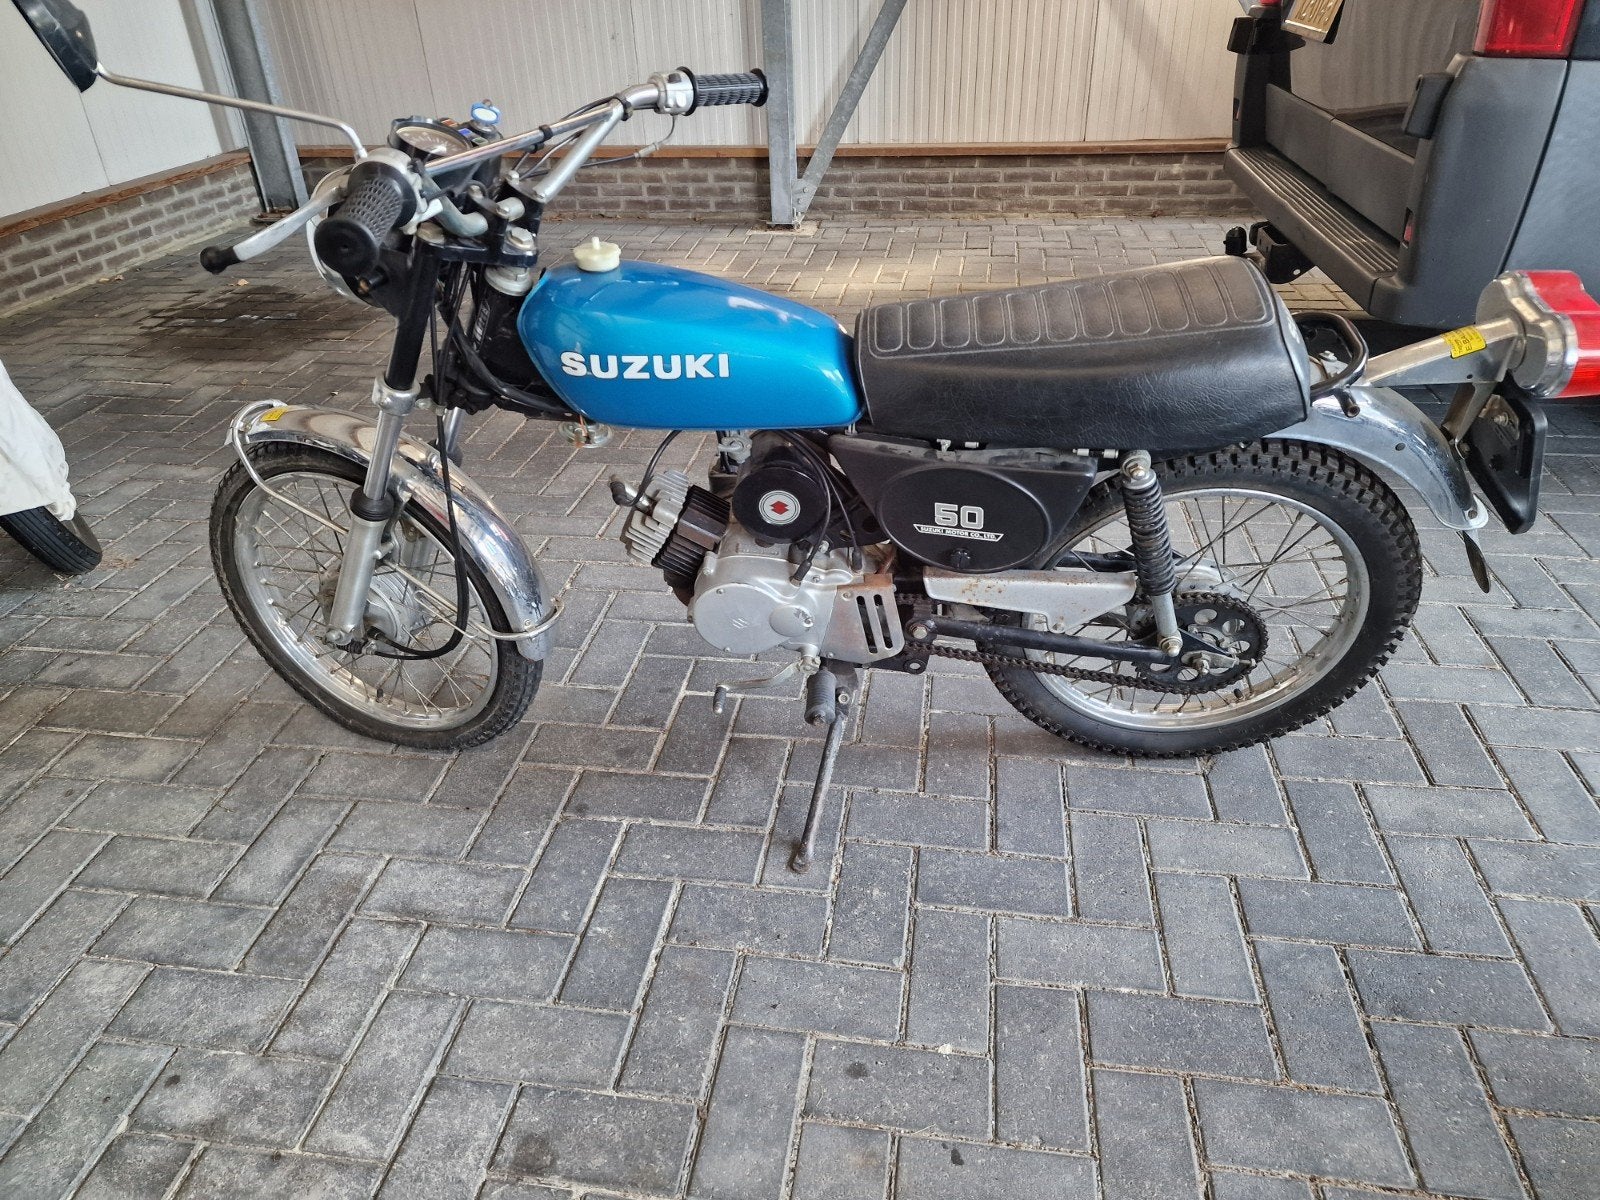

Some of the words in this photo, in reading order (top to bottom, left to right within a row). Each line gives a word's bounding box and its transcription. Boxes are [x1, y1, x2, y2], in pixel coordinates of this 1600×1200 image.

[560, 351, 730, 380] SUZUKI
[934, 502, 984, 530] 50
[920, 526, 944, 534] SUZUKI
[945, 528, 969, 537] MOTOR
